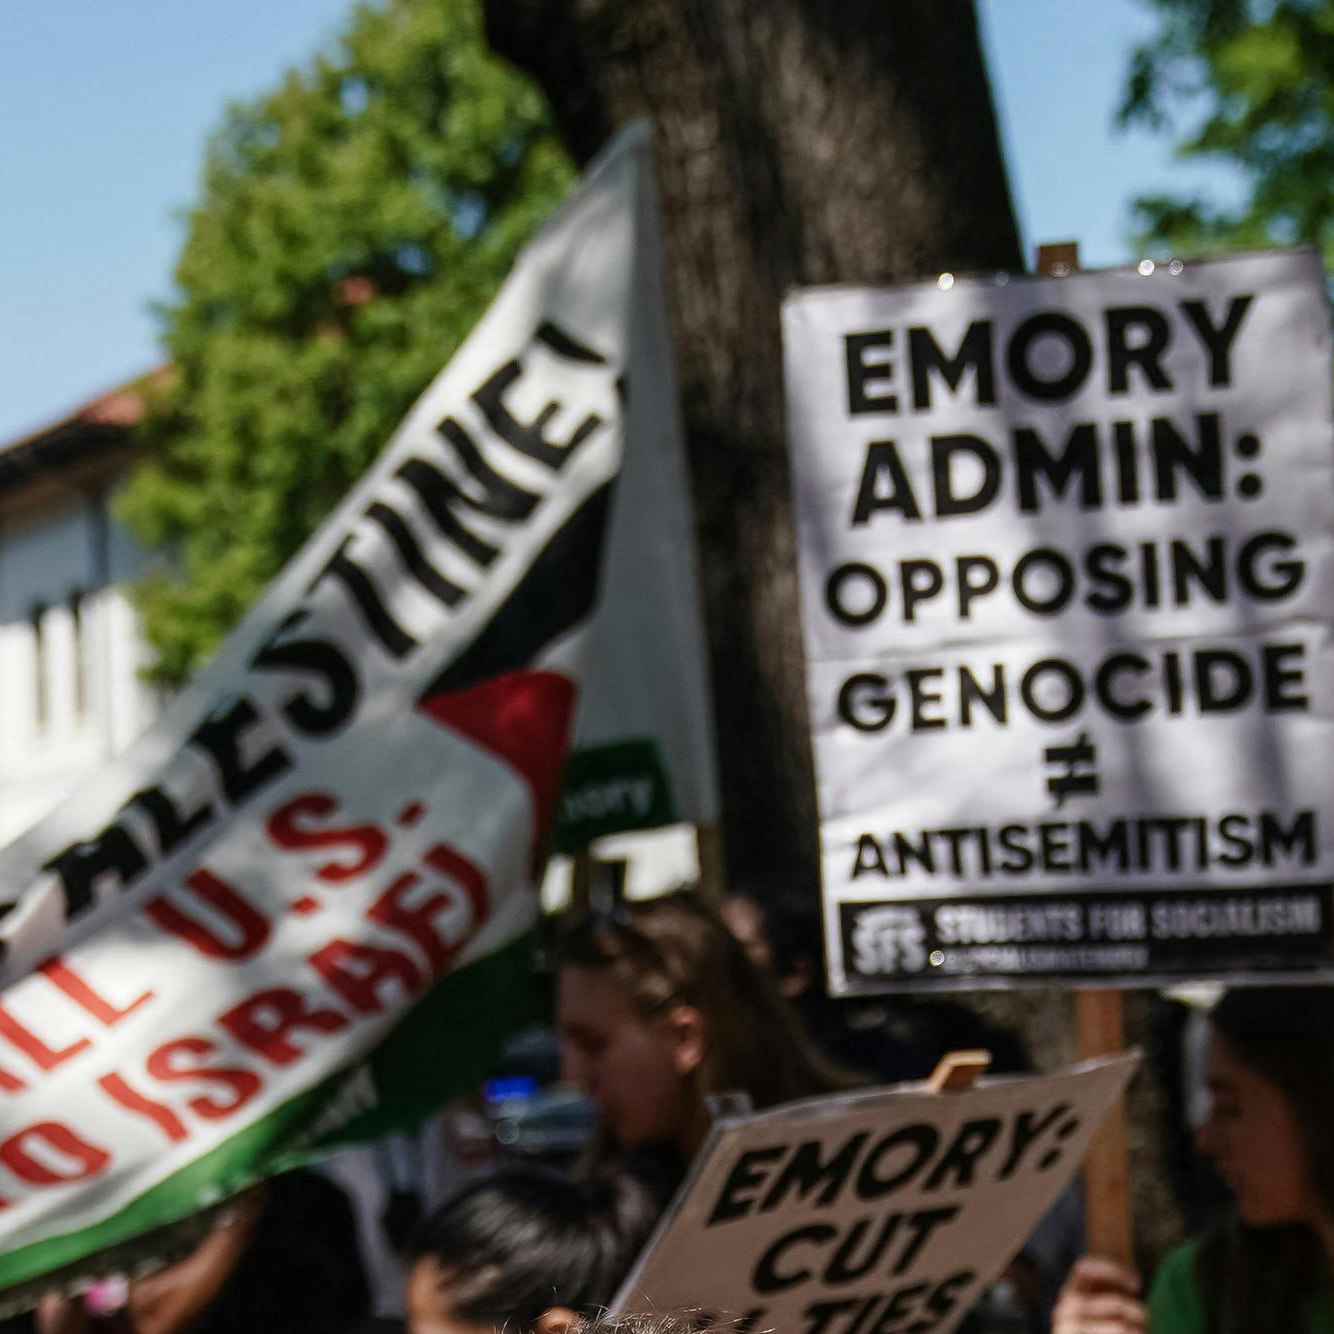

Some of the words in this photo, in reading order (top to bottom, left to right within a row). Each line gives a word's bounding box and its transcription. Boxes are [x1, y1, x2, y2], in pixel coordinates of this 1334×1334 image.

[842, 295, 1253, 417] EMORY
[851, 413, 1264, 527] ADMIN:
[825, 531, 1305, 627] OPPOSING
[836, 643, 1310, 733] GENOCIDE
[142, 791, 426, 966] U.S.
[849, 811, 1318, 881] ANTISEMITISM
[933, 902, 1085, 944] STUDENTS
[1087, 903, 1147, 941] FOR
[1150, 895, 1322, 939] SOCIALISM
[706, 1102, 1080, 1227] EMORY:
[750, 1205, 961, 1294] CUT
